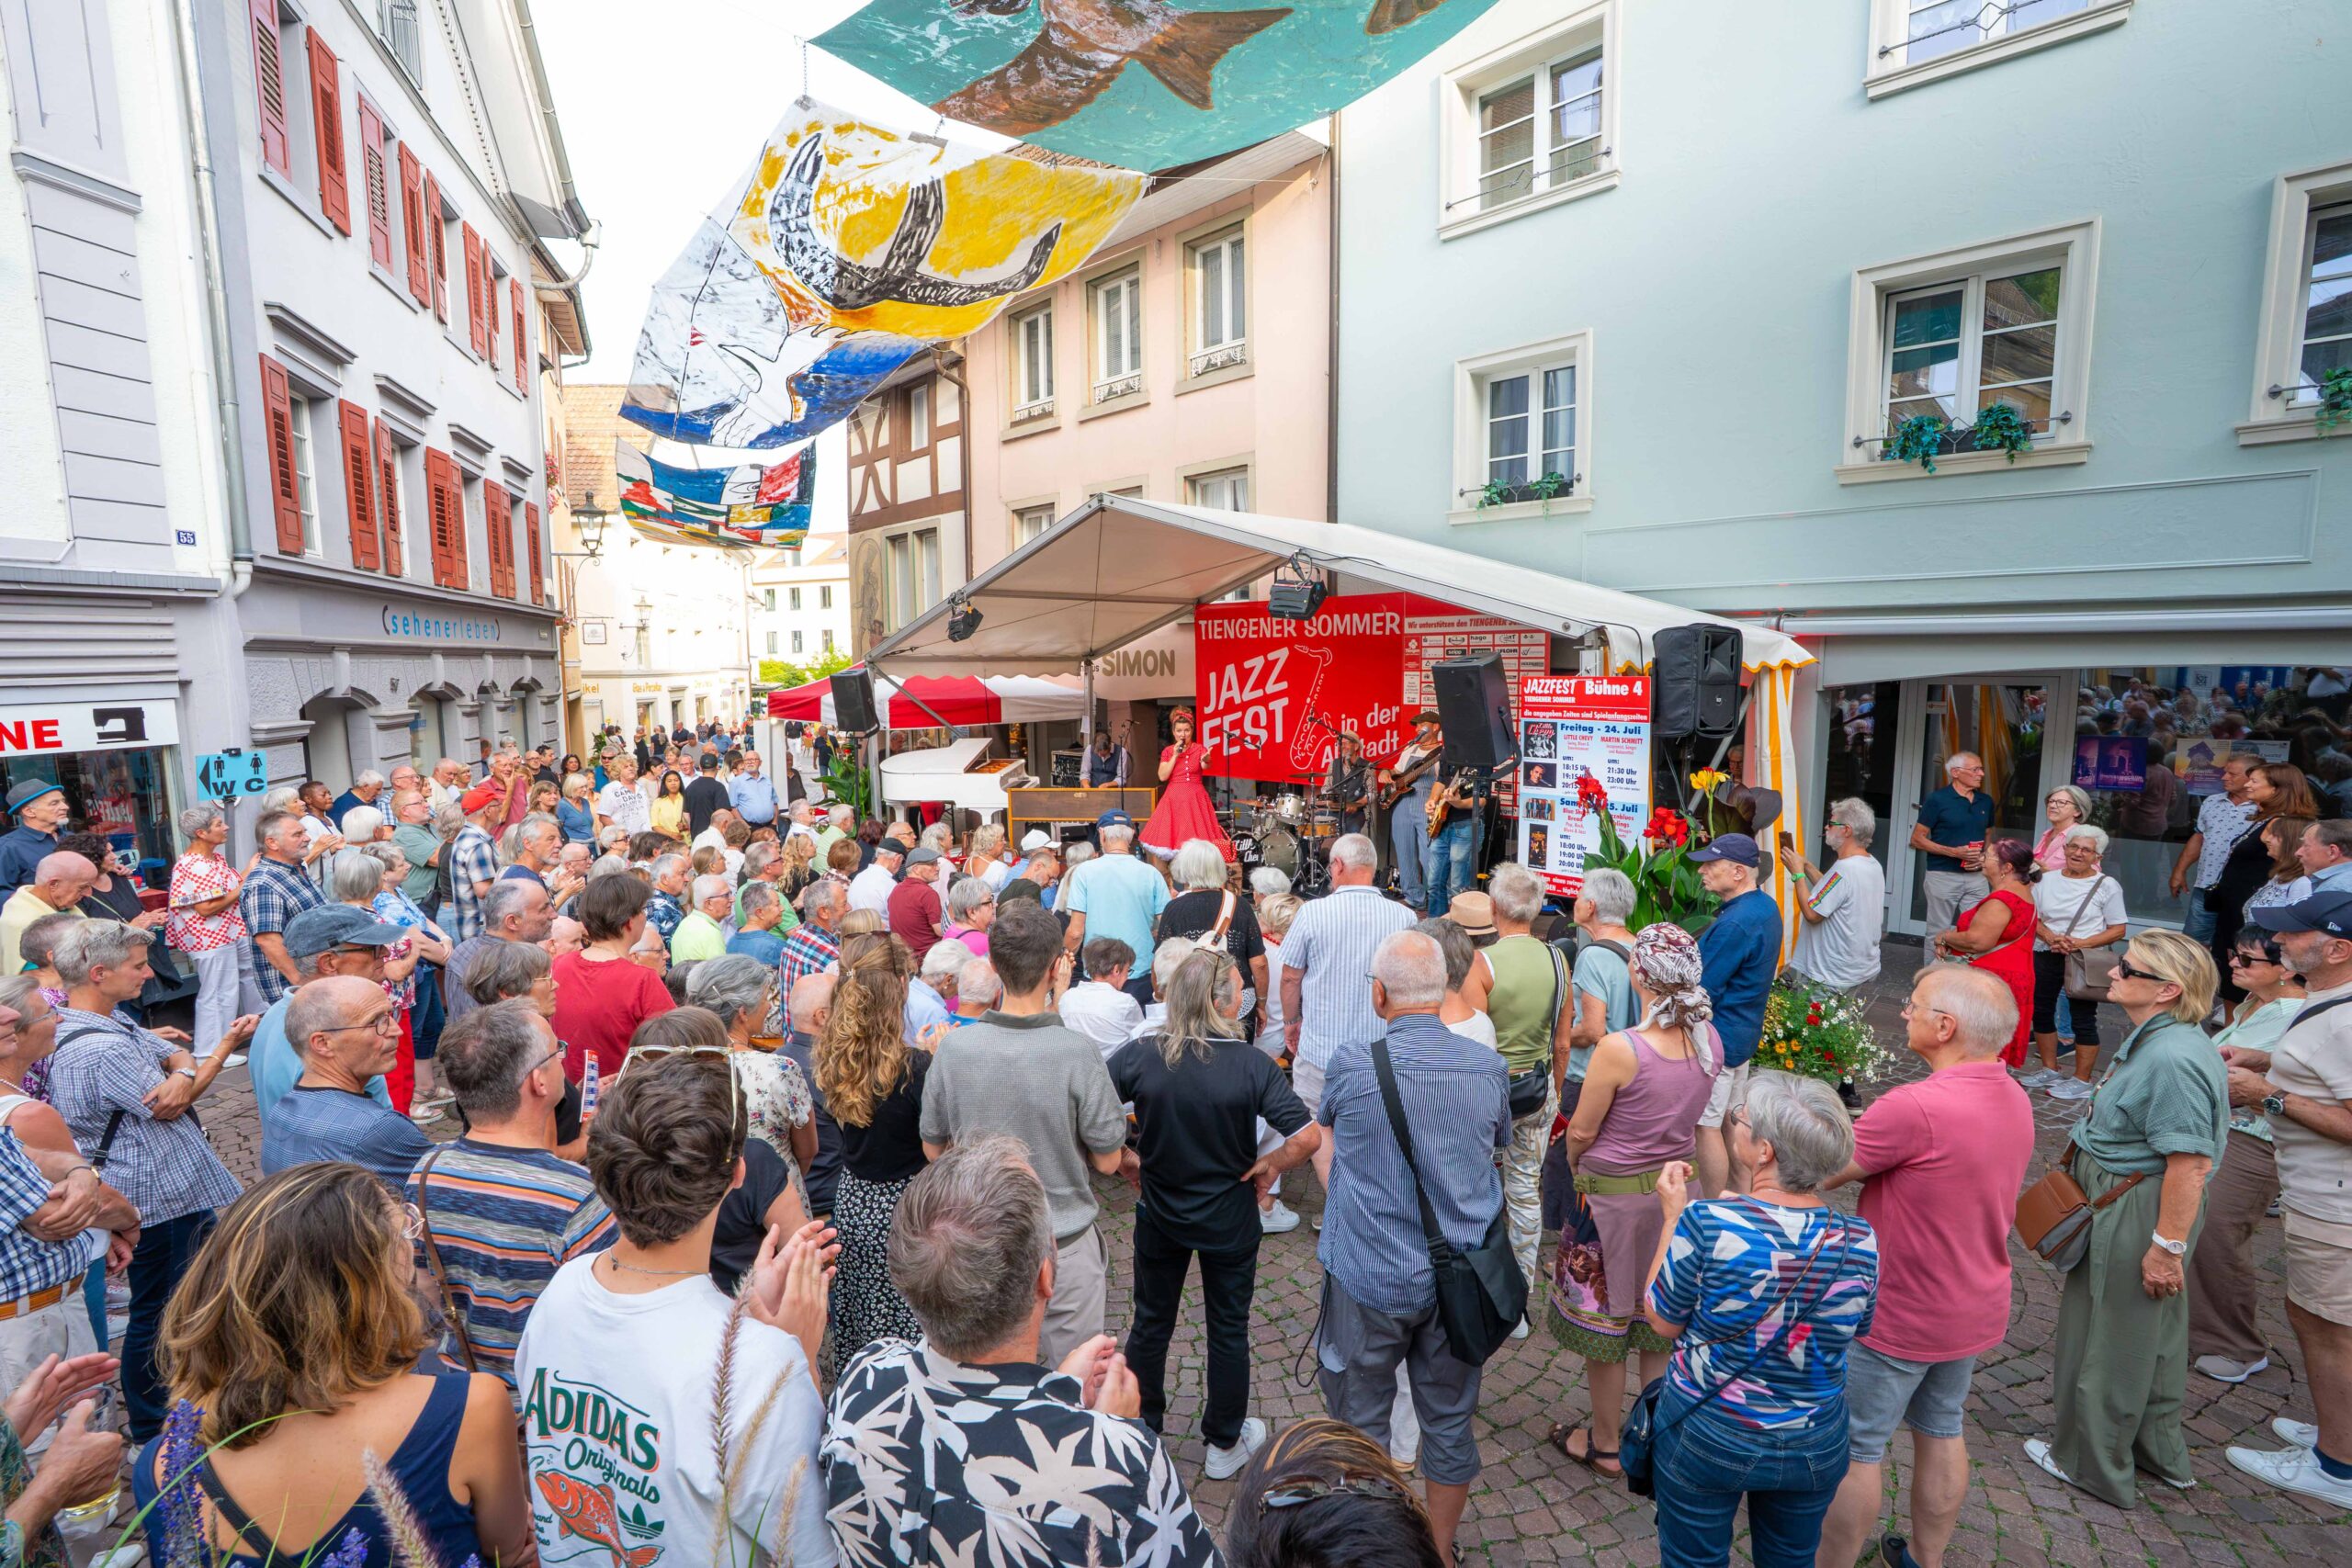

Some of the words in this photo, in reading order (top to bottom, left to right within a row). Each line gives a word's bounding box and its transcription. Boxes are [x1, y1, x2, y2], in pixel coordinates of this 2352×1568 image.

[179, 531, 194, 545] 55
[1198, 617, 1297, 640] TIENGENER
[1304, 612, 1401, 637] SOMMER
[1408, 621, 1418, 629] Wir
[1419, 619, 1455, 629] unterstützen
[1456, 619, 1468, 627] den
[1102, 649, 1176, 677] SIMON
[1204, 647, 1290, 715] JAZZ
[1523, 678, 1577, 694] JAZZFEST
[1585, 679, 1630, 696] Bühne
[1633, 681, 1643, 696] 4
[1524, 695, 1552, 704] TIENGENER
[1340, 714, 1359, 733] in
[1366, 702, 1400, 728] der
[1523, 709, 1532, 717] die
[1563, 710, 1580, 719] Zeiten
[1581, 711, 1593, 719] sind
[1594, 711, 1648, 722] Spielanfangszeiten
[1202, 697, 1289, 757] FEST
[1560, 723, 1594, 734] Freitag
[1604, 725, 1621, 735] 24.
[1623, 725, 1642, 735] Juli
[1562, 763, 1579, 772] 18:15
[1625, 767, 1637, 776] Uhr
[1561, 782, 1578, 790] 20:15
[1607, 776, 1625, 784] 23:00
[1621, 804, 1639, 814] Juli
[1559, 841, 1576, 850] 18:00
[1559, 851, 1576, 859] 19:00
[1558, 860, 1575, 868] 20:00
[524, 1367, 661, 1473] ADIDAS
[564, 1437, 661, 1504] Originals
